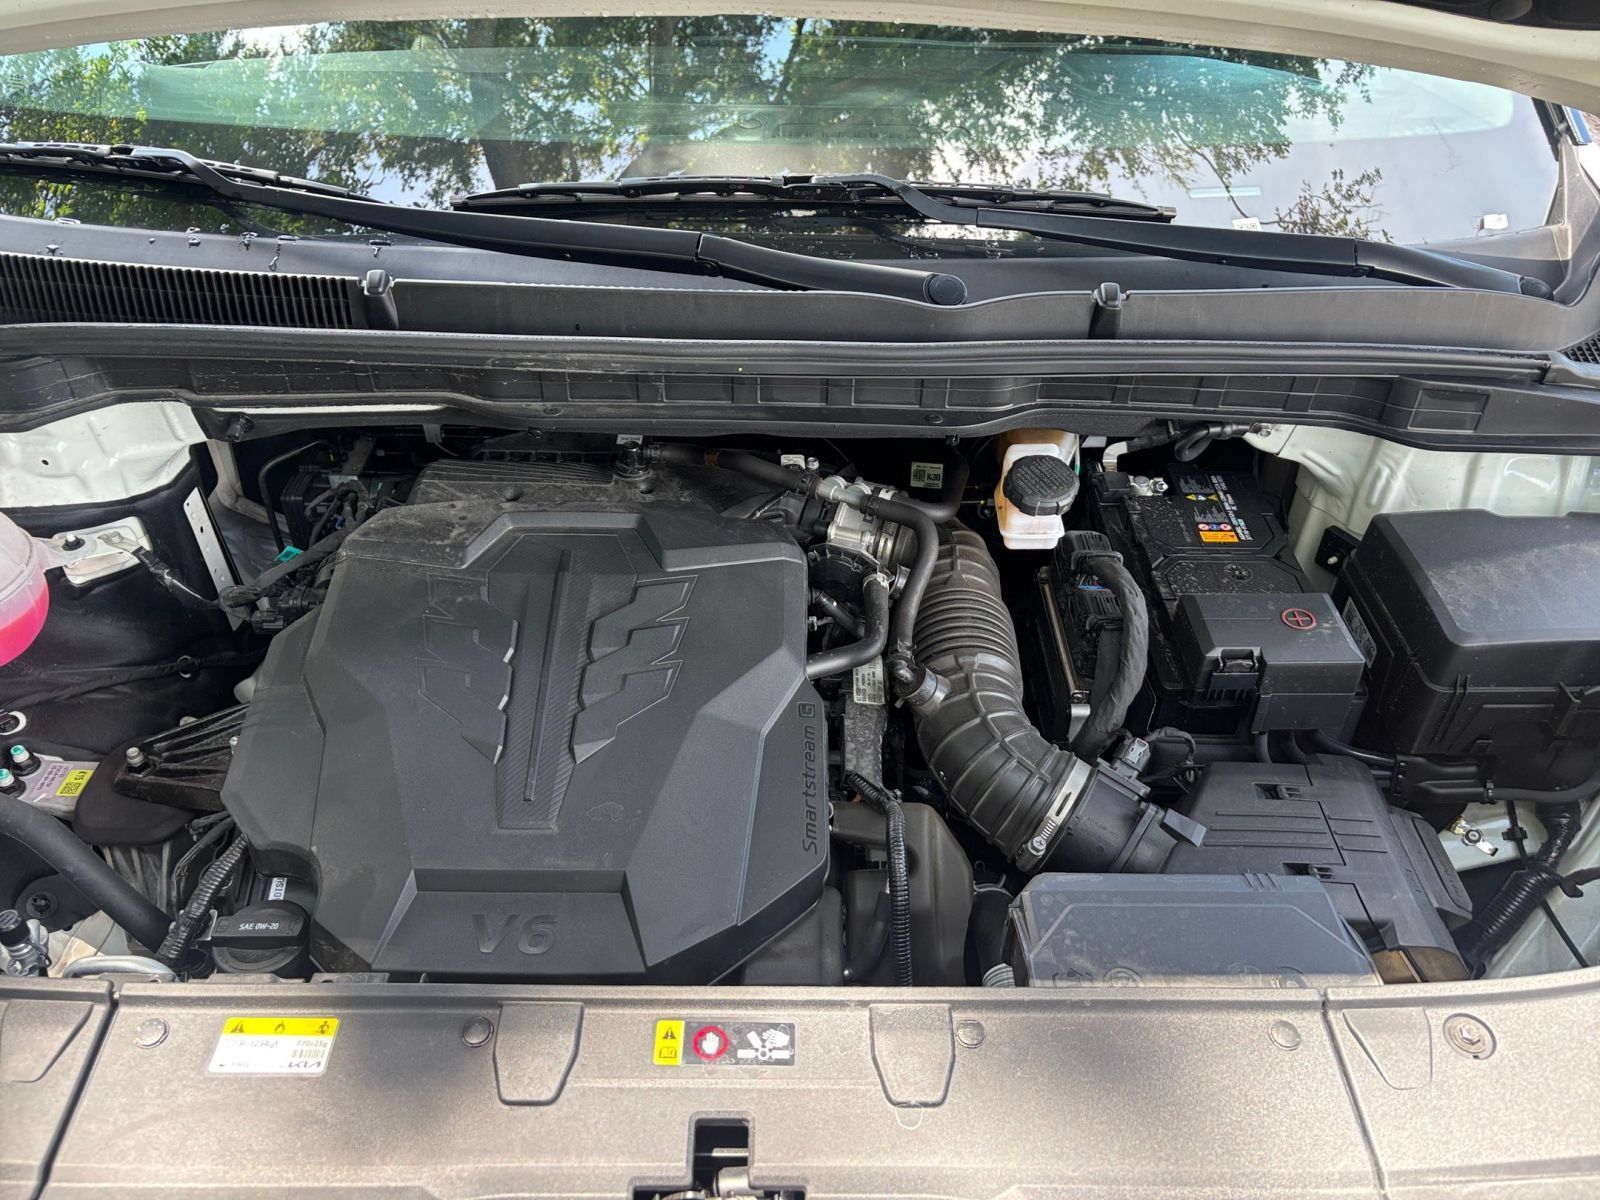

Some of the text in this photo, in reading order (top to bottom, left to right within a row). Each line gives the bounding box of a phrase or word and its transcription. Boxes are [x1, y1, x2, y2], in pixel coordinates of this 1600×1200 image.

[802, 725, 817, 855] Smartstream
[238, 922, 279, 931] SAE 0W-20
[471, 913, 557, 954] V6
[287, 1060, 322, 1068] KIA
